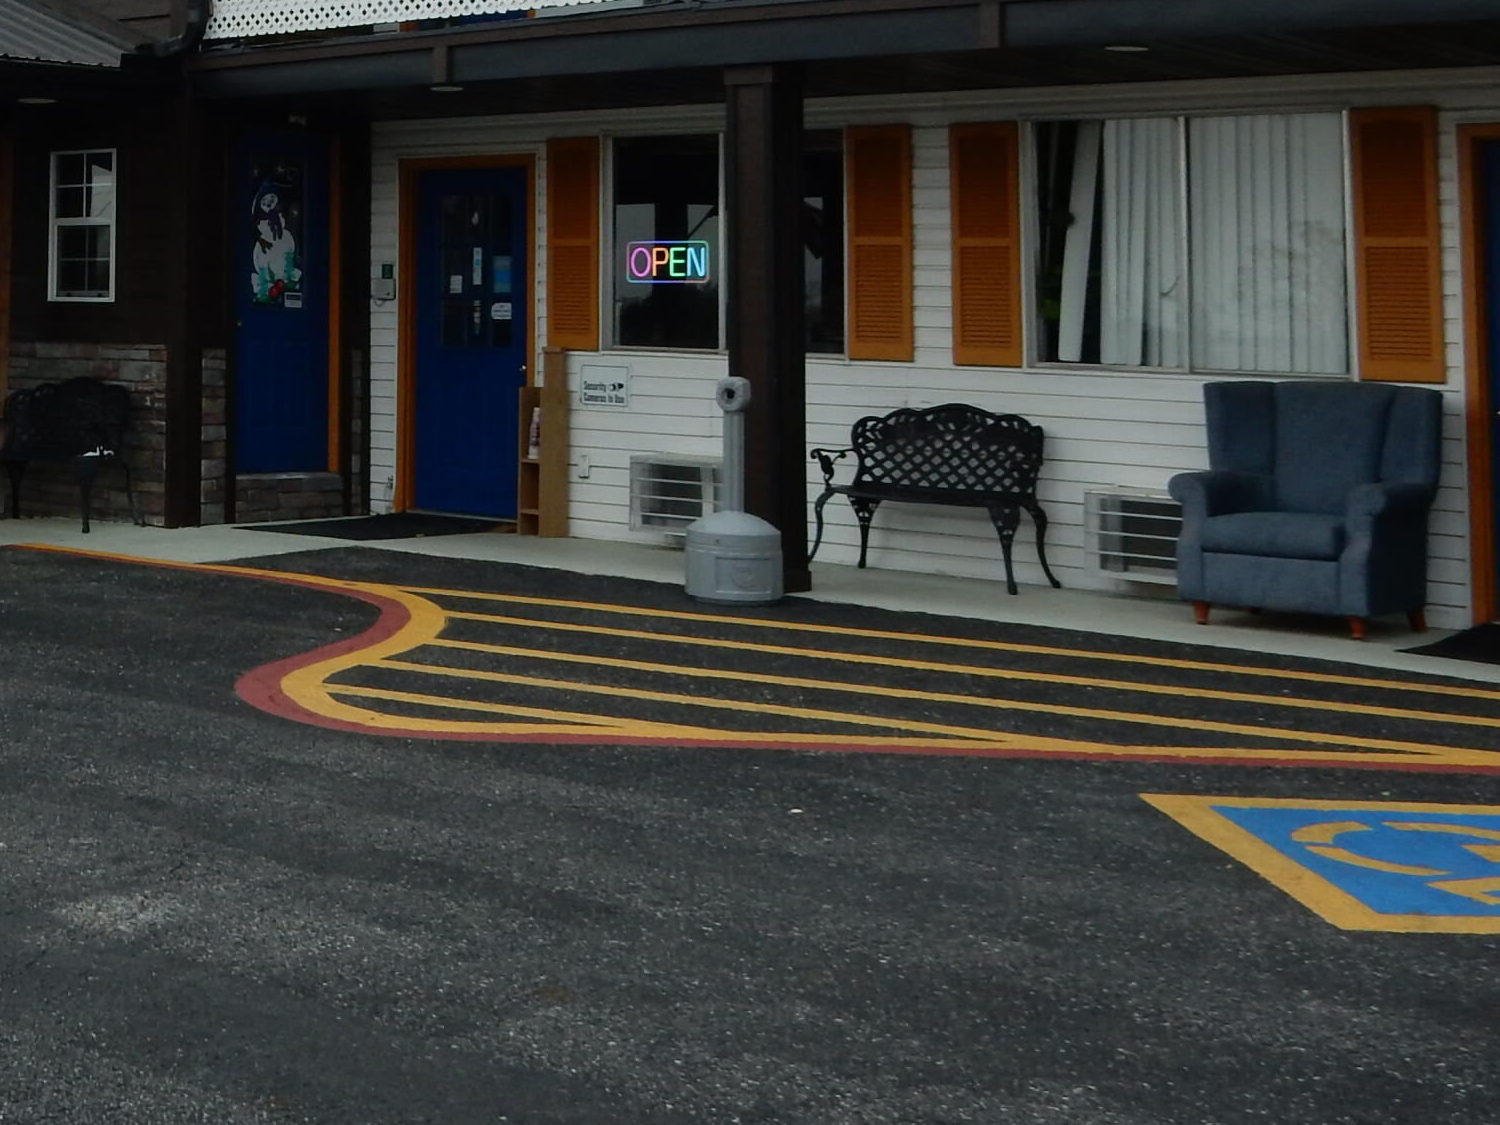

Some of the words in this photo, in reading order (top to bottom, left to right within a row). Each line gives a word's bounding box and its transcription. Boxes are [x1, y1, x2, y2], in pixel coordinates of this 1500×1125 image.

[630, 247, 706, 278] OPEN
[583, 381, 607, 393] Security
[583, 392, 607, 403] Cameras
[615, 394, 625, 404] Use
